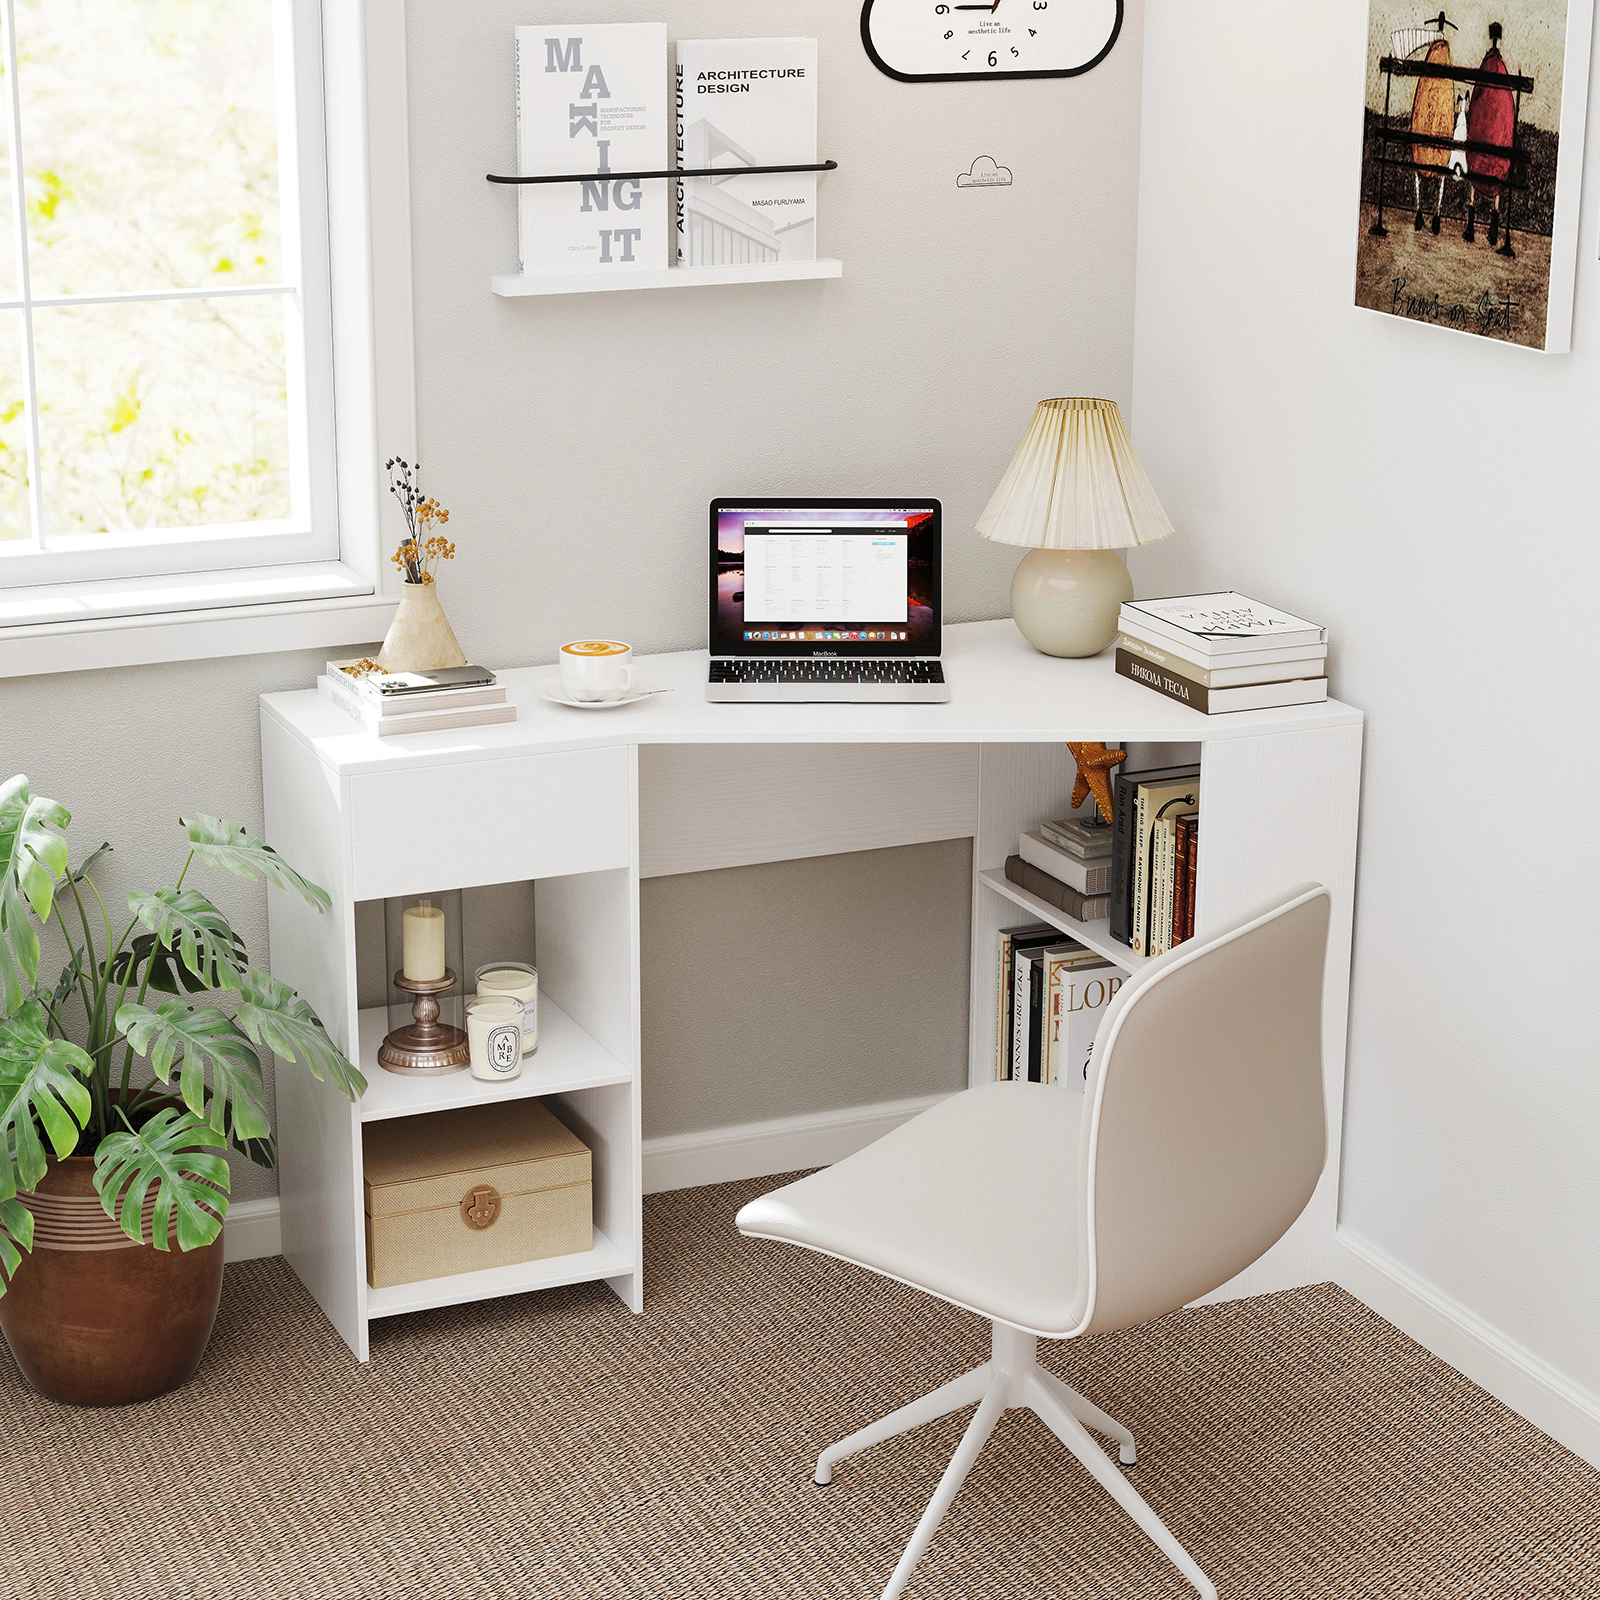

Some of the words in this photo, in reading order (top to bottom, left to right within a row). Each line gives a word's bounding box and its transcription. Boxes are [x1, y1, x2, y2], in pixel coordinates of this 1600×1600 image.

[943, 30, 954, 40] 8
[1028, 28, 1037, 37] 4
[987, 50, 997, 67] 6
[1010, 46, 1019, 58] 5
[696, 68, 806, 81] ARCHITECTURE
[697, 83, 750, 94] DESIGN
[675, 64, 685, 233] ARCHITECTURE
[774, 198, 806, 206] FURUYAMA
[598, 228, 641, 263] IT
[1130, 662, 1162, 687] НИКОЛА
[1163, 677, 1190, 700] ТЕСЛА
[1119, 785, 1127, 808] Ron
[1118, 809, 1126, 834] Arad
[1135, 895, 1143, 933] CHANDLER
[1068, 974, 1132, 1012] LOR
